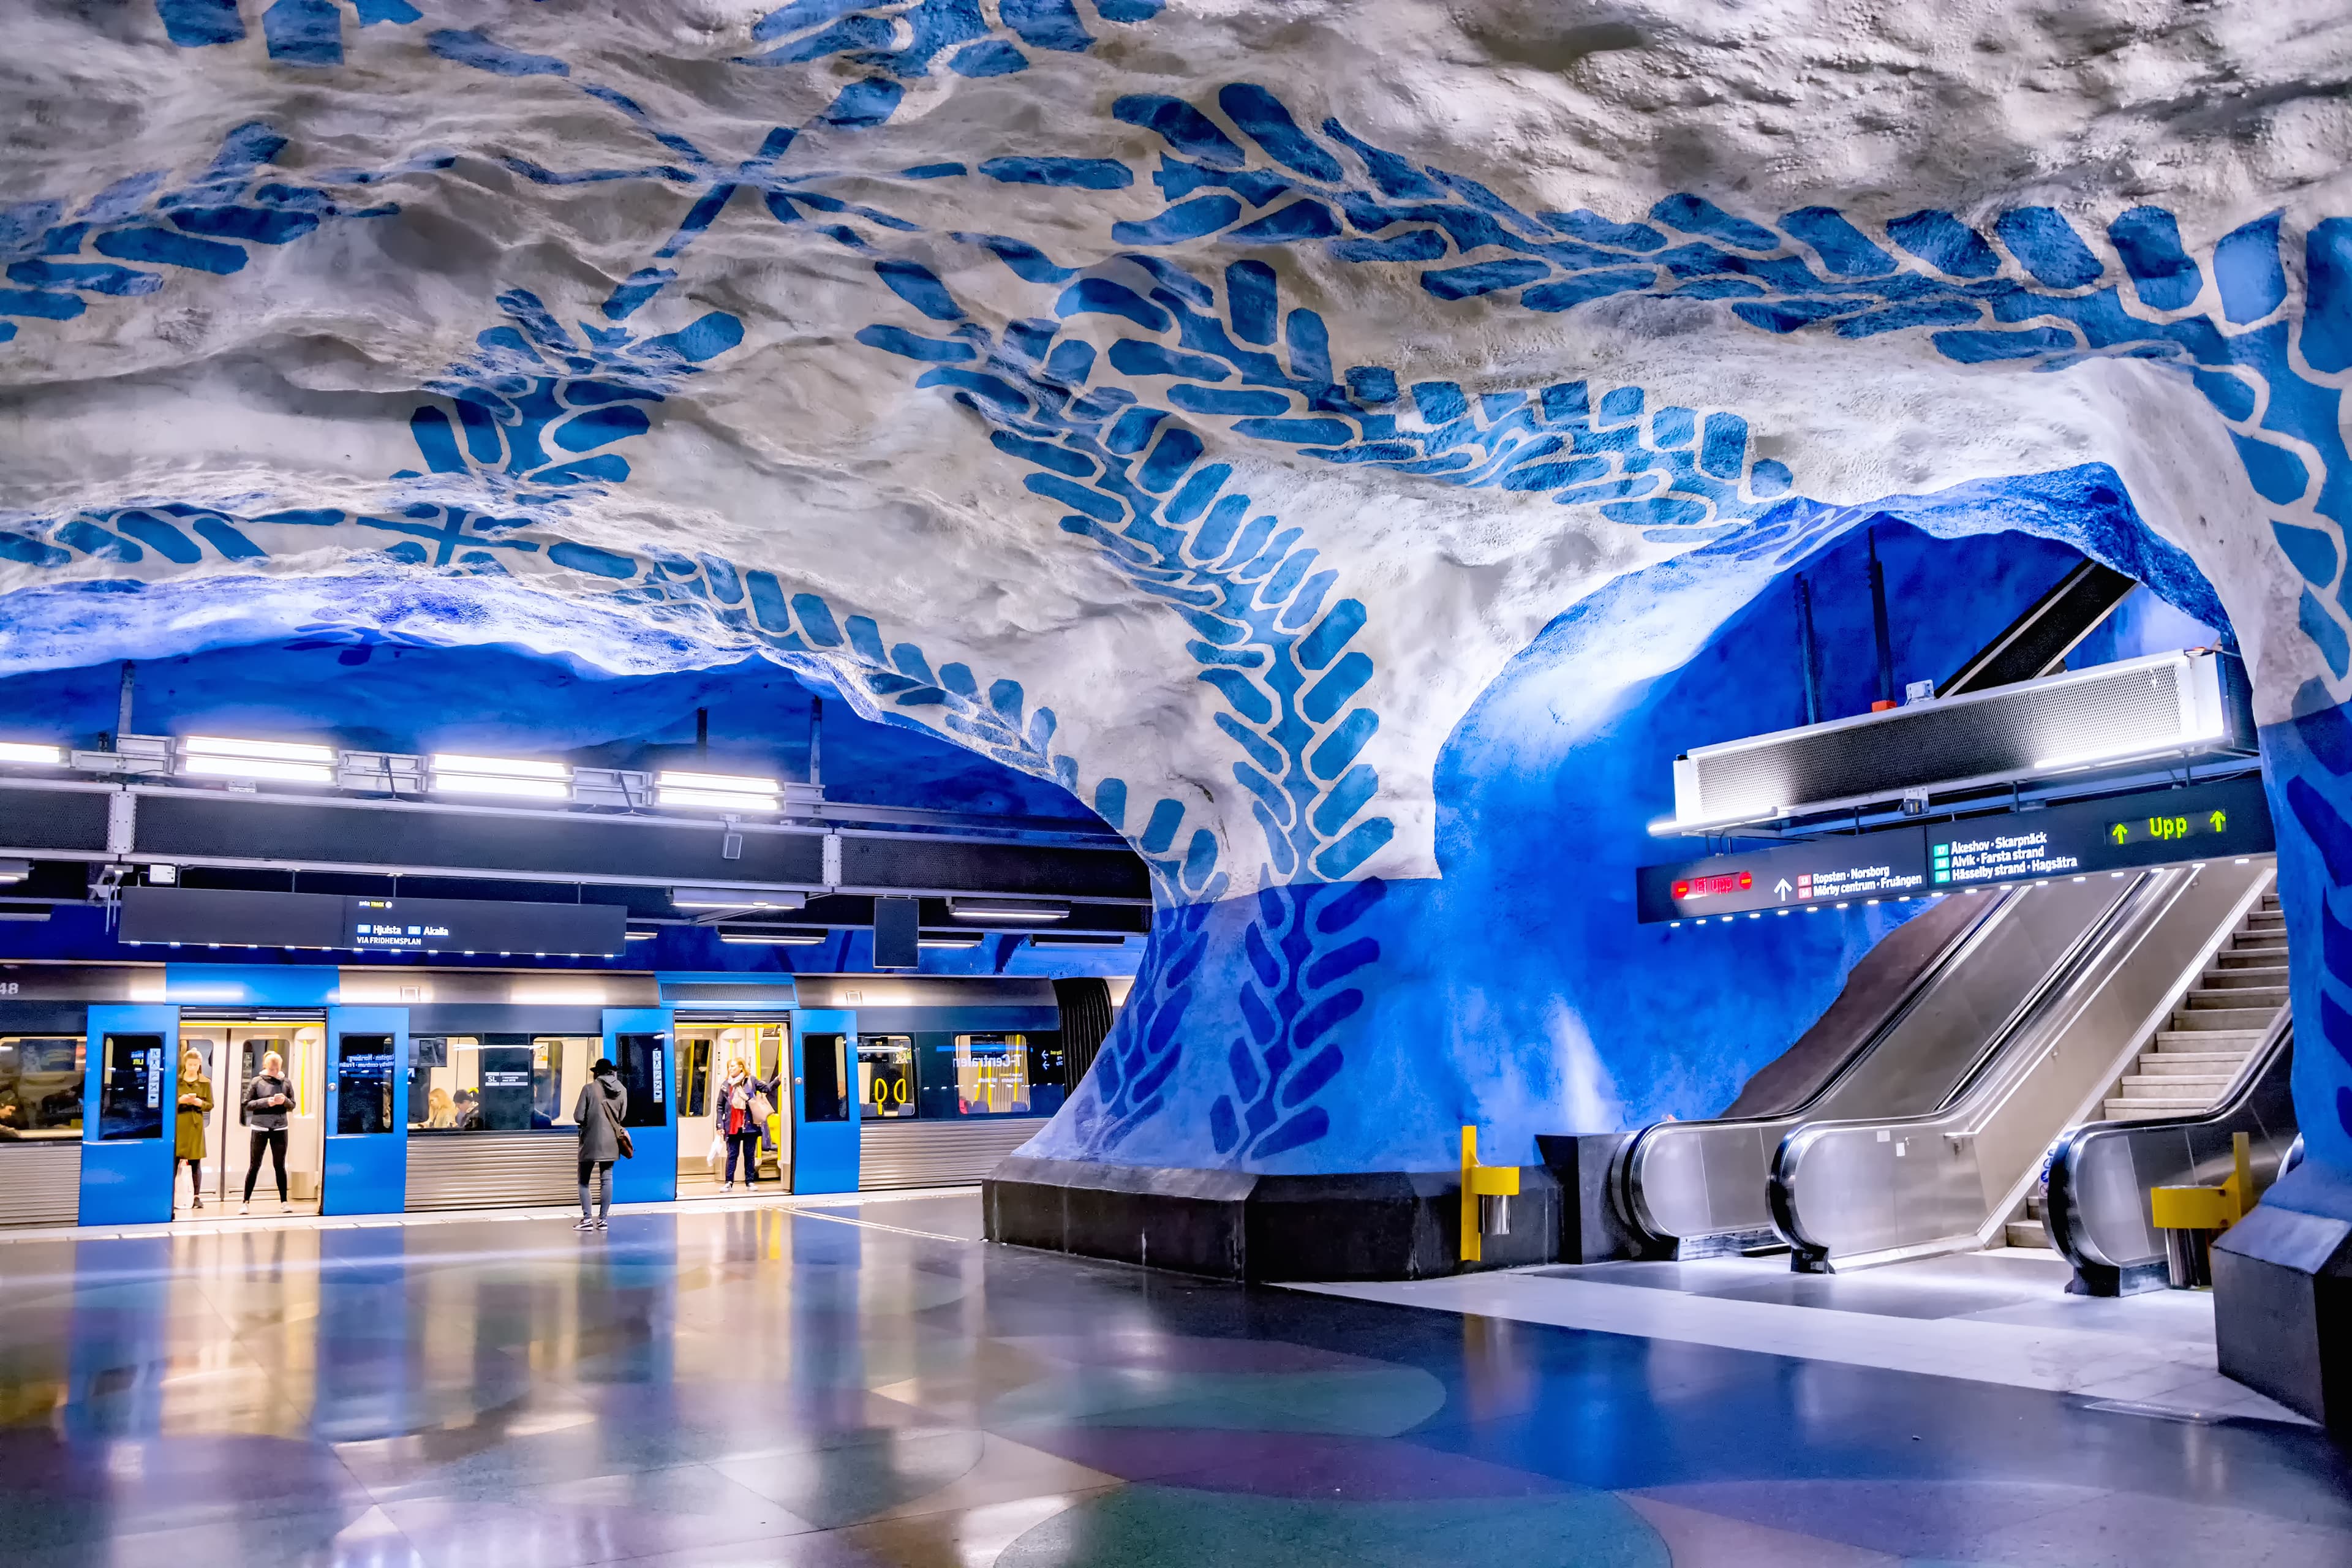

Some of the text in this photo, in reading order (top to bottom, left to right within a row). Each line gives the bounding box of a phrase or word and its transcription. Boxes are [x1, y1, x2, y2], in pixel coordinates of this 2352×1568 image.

[2149, 816, 2187, 840] Upp
[1951, 840, 1989, 855] Åkeshov
[1995, 831, 2047, 849] Skarpnäck
[1951, 856, 1976, 868] Alvik
[1980, 850, 2011, 864] Farsta
[2012, 845, 2045, 858] strand
[1813, 872, 1846, 885] Ropsten
[1851, 865, 1890, 880] Norsborg
[1952, 865, 1993, 881] Hässelby
[1994, 861, 2026, 876] strand
[2032, 856, 2078, 872] Hagsätra
[1814, 884, 1841, 896] Mörby
[1841, 880, 1875, 893] centrum
[1880, 875, 1922, 889] Fruängen
[373, 925, 402, 935] Hjulsta
[423, 926, 449, 936] Akalla
[0, 982, 18, 995] 48
